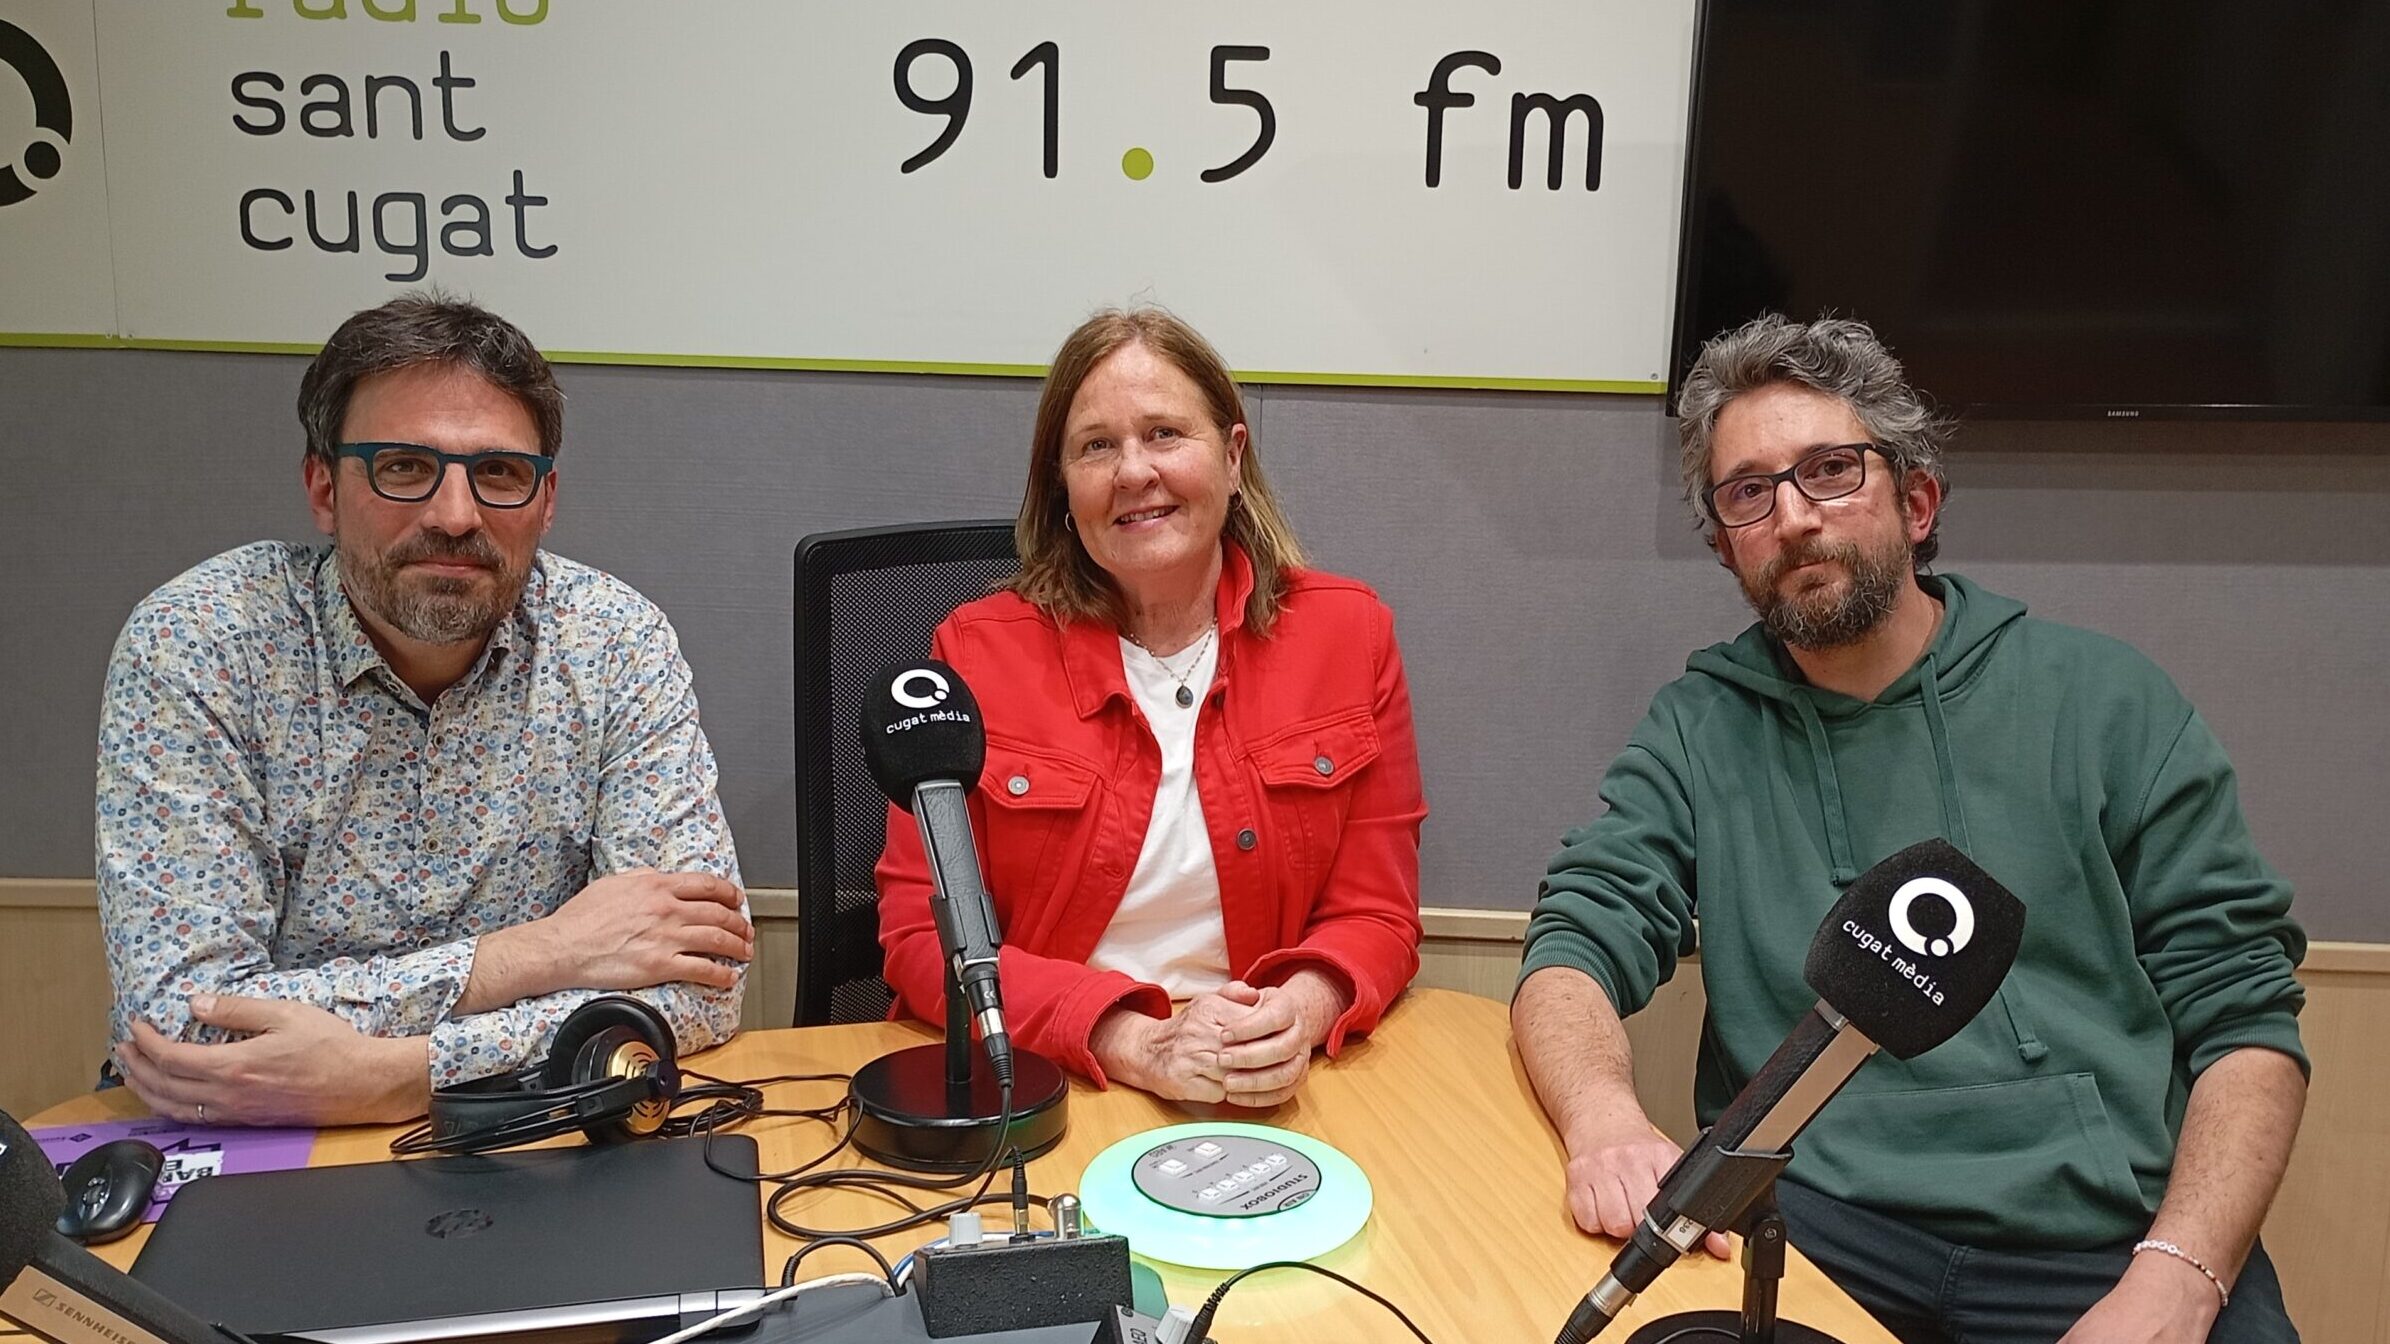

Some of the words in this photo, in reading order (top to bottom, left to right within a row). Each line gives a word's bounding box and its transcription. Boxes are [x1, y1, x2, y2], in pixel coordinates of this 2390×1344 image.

[230, 50, 486, 142] sant
[893, 38, 1277, 183] 91.5
[1413, 50, 1604, 191] fm
[239, 169, 558, 282] cugat
[886, 712, 928, 734] cugat
[930, 710, 971, 723] mèdia
[1842, 920, 1894, 961] cugat
[1891, 957, 1945, 1007] mèdia
[1240, 1174, 1308, 1210] STUDIOBOX
